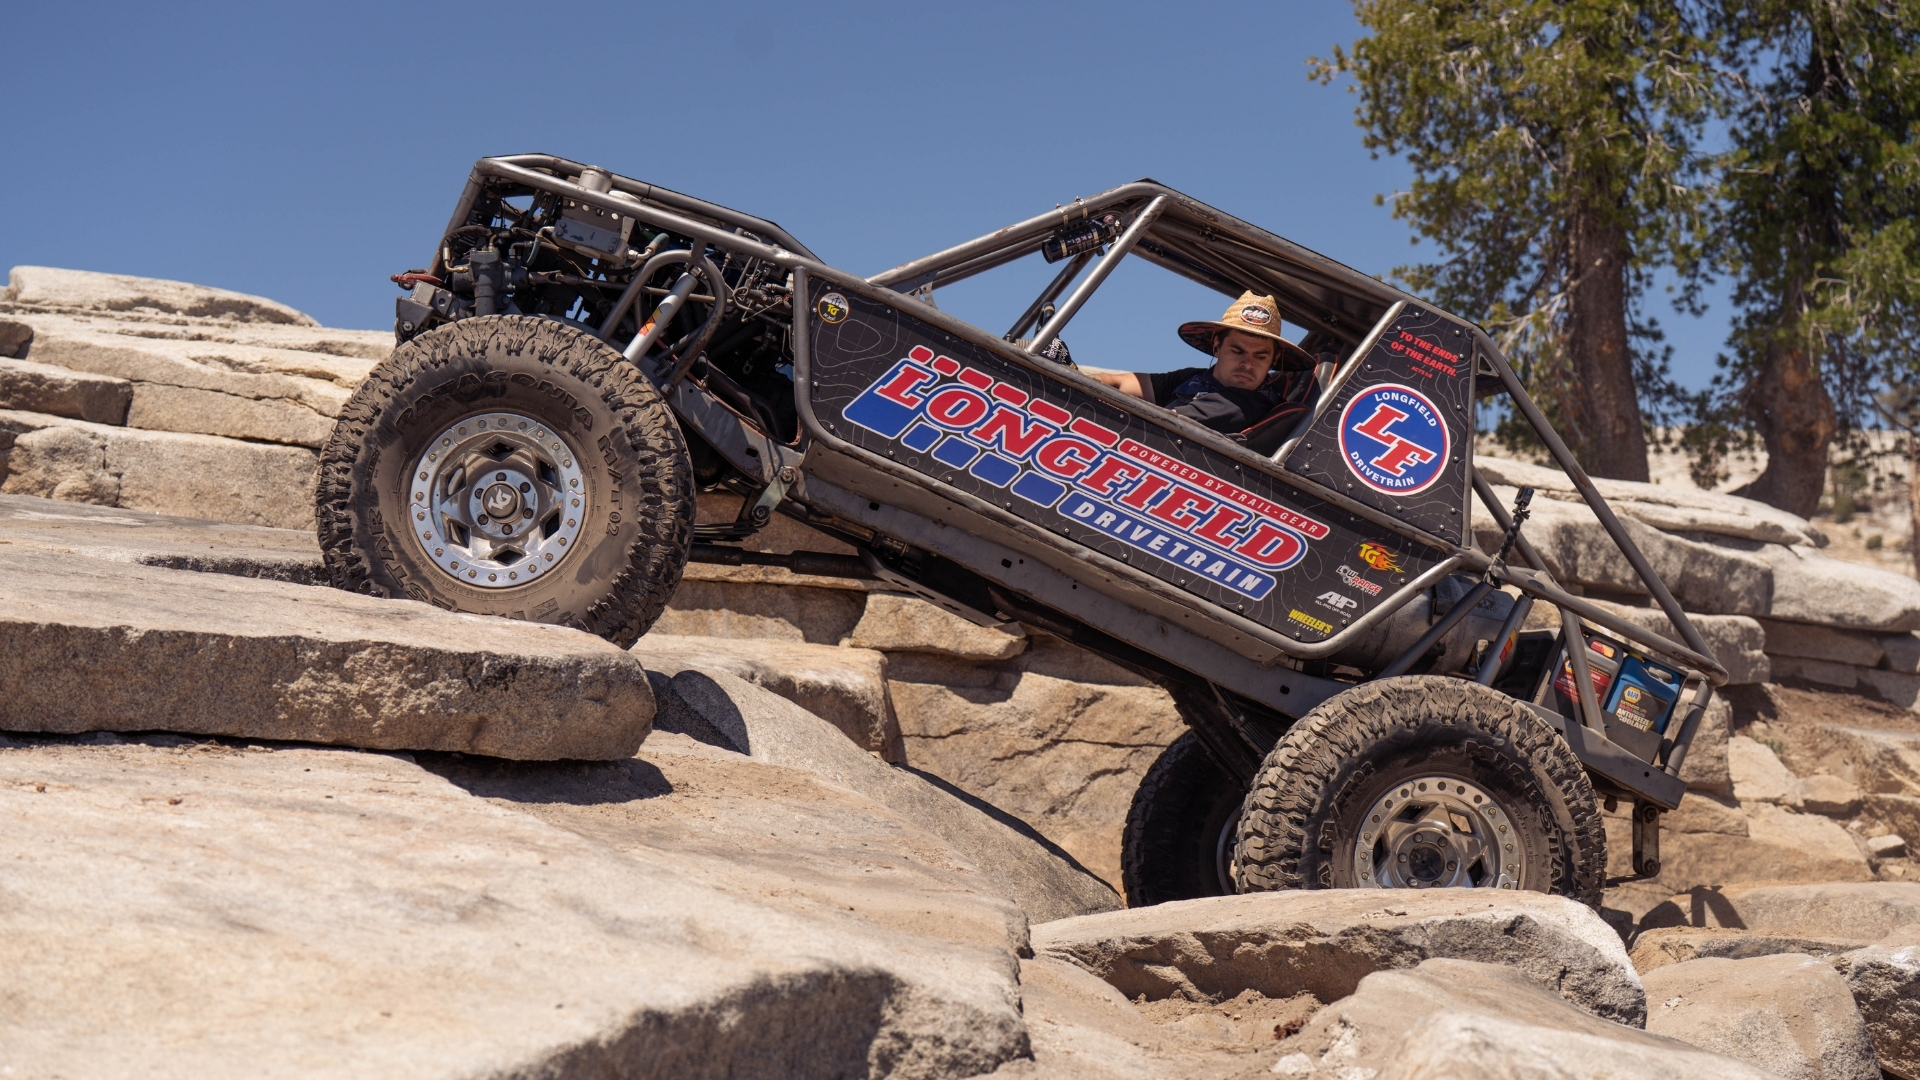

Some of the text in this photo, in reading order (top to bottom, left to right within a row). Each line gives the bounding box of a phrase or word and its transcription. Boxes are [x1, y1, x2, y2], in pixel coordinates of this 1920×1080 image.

[827, 303, 840, 316] TG
[1390, 341, 1457, 377] OF THE EARTH.
[1399, 331, 1459, 363] TO THE ENDS
[1411, 366, 1425, 374] ACTS
[396, 371, 593, 428] PATAGONIA
[1374, 392, 1437, 427] LONGFIELD
[1352, 402, 1438, 477] LF
[873, 361, 1308, 571] LONGFIELD
[1351, 452, 1415, 487] DRIVETRAIN
[1128, 445, 1318, 533] POWERED BY TRAIL-GEAR
[1072, 501, 1263, 592] DRIVETRAIN
[1360, 543, 1381, 565] TG
[1351, 575, 1383, 594] RANGE
[1289, 609, 1333, 634] WHEELER'S
[1627, 690, 1639, 700] NAPA
[1617, 708, 1650, 726] ANTIFREEZE
[1619, 714, 1648, 732] COOLANT
[1464, 740, 1565, 895] MILESTA
